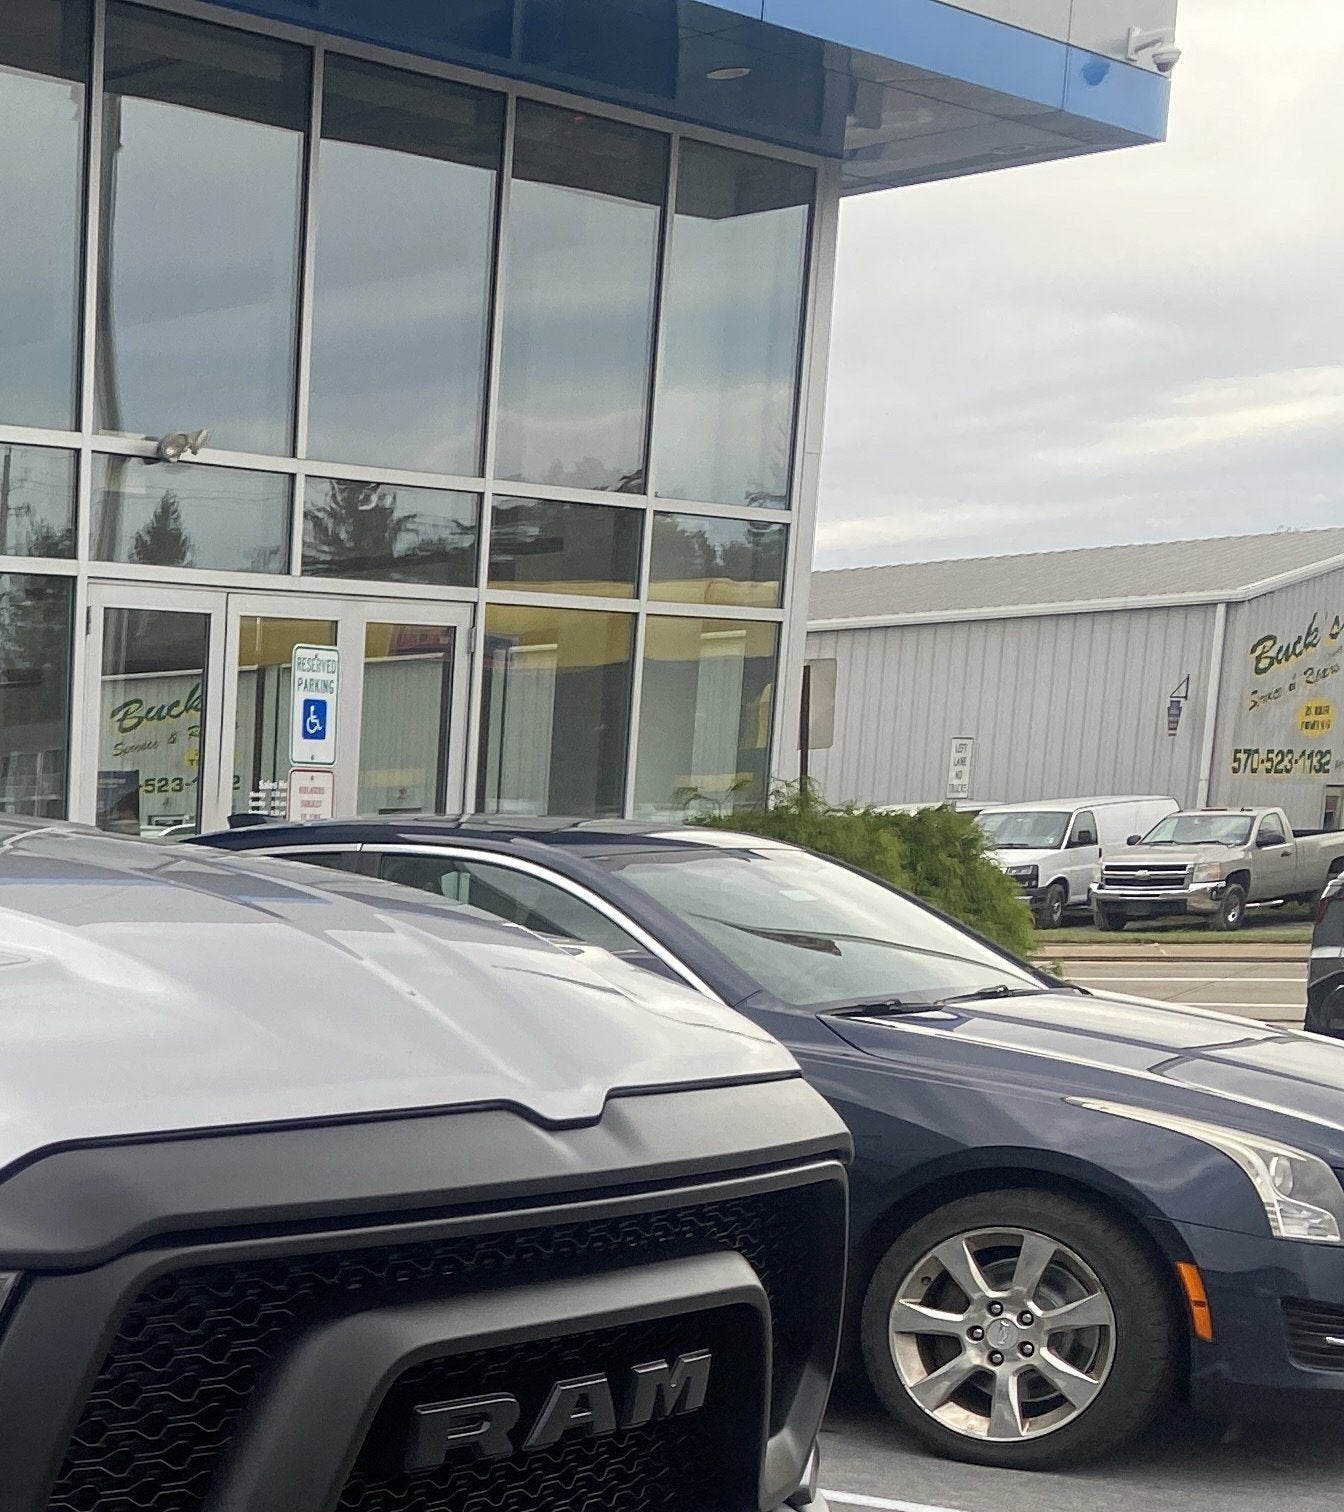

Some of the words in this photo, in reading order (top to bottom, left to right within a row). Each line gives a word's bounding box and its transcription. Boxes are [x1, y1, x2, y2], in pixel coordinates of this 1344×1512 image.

[296, 656, 337, 675] RESERVED
[297, 677, 335, 694] PARKING
[404, 1346, 713, 1474] RAM
